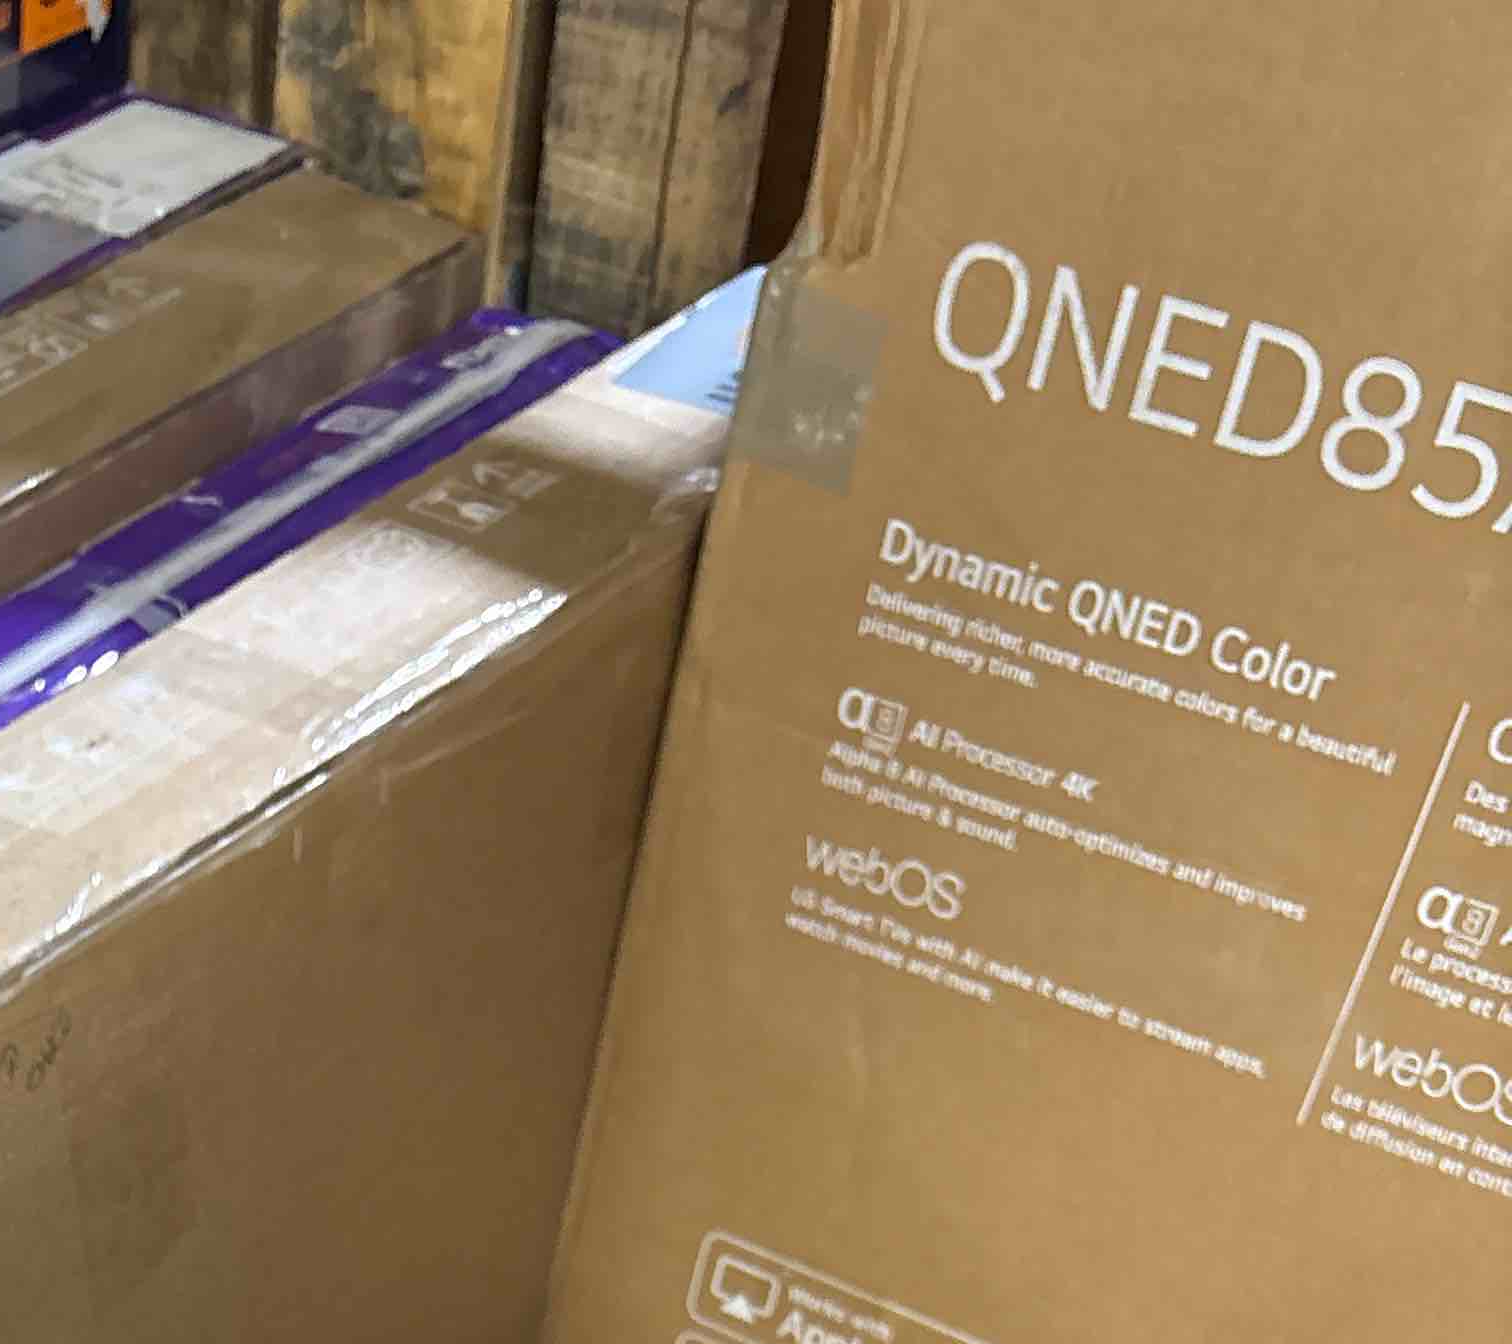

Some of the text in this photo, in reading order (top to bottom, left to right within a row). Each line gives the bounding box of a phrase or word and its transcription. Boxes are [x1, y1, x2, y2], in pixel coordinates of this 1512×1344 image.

[933, 241, 1512, 535] QNED85
[879, 517, 1337, 701] Dynamic QNED Color
[1027, 640, 1082, 672] more
[1083, 657, 1173, 703] accurate
[1174, 688, 1239, 725] colors
[1241, 705, 1278, 737] for
[1277, 722, 1295, 743] a
[1295, 721, 1398, 776] beautiful
[941, 727, 1057, 789] Processor
[1060, 770, 1100, 803] 4K
[1464, 779, 1509, 814] Des
[805, 832, 967, 920] webOS
[1172, 861, 1216, 890] and
[1213, 871, 1307, 923] improves
[1399, 935, 1429, 966] Le
[1468, 995, 1495, 1019] et
